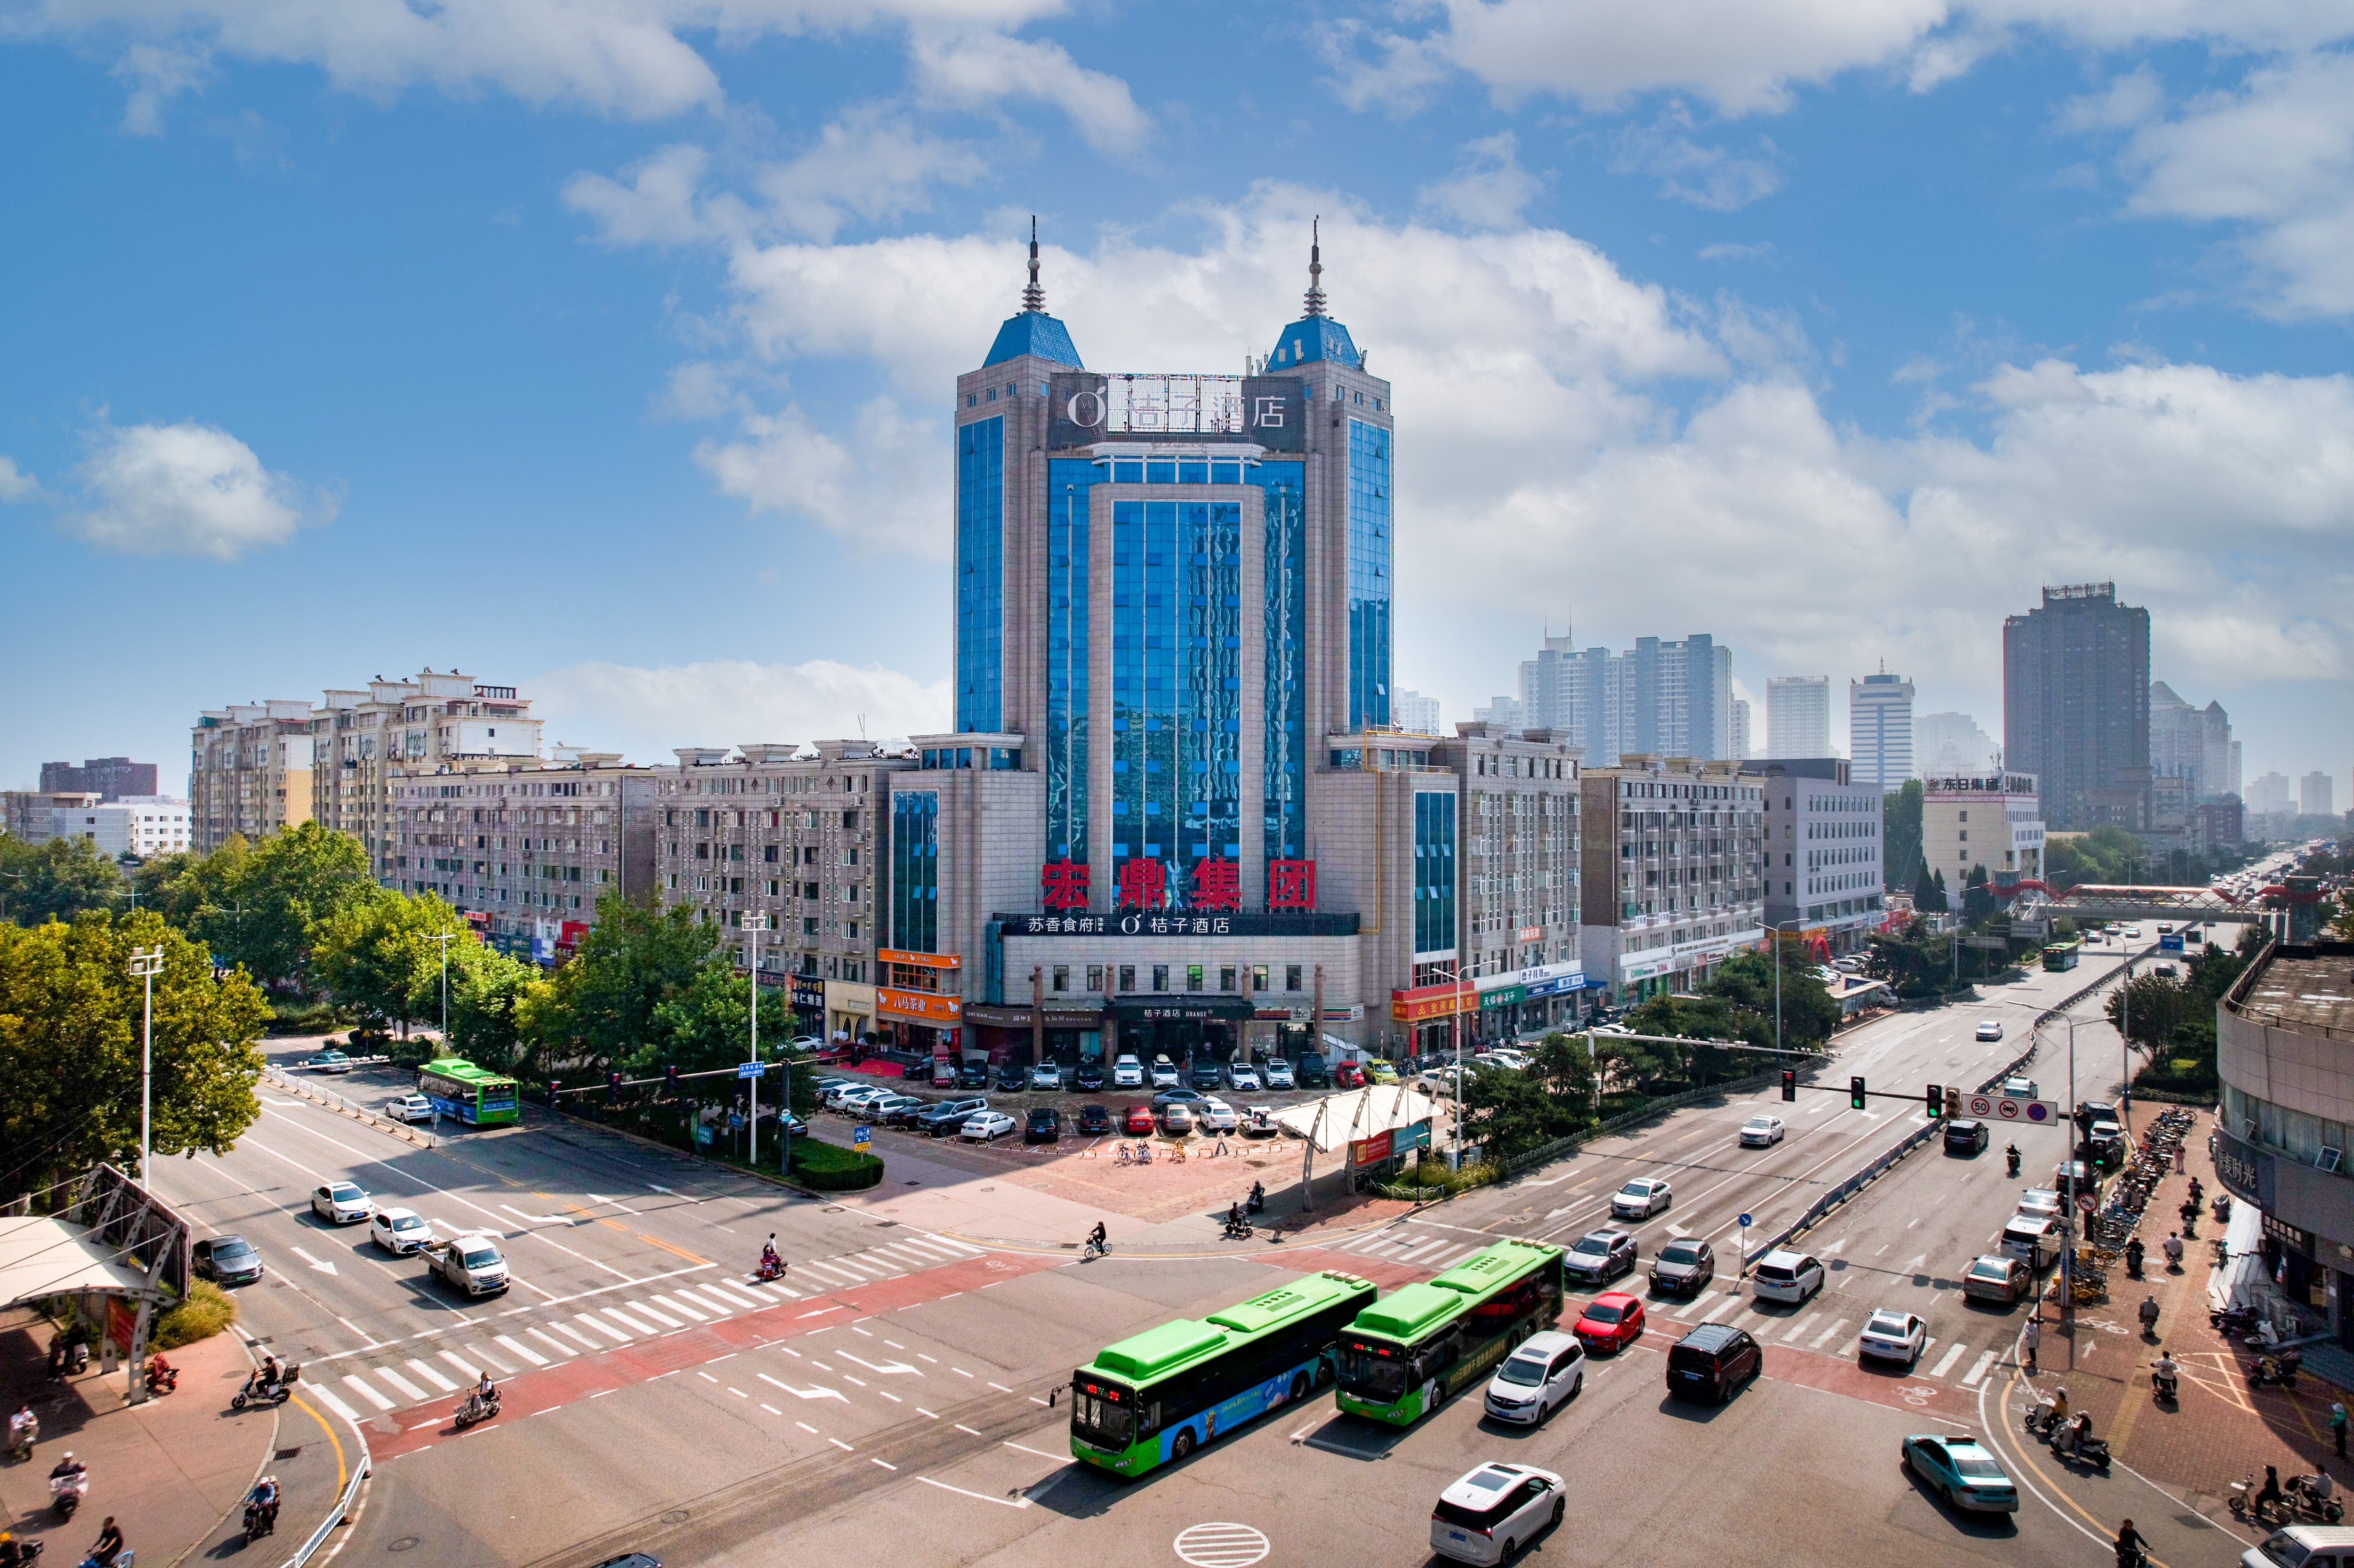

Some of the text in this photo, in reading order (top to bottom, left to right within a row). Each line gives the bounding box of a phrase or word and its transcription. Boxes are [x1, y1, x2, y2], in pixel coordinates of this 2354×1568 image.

[1124, 394, 1286, 427] 桔子酒店
[1943, 778, 1999, 791] 东日集团
[1041, 858, 1316, 910] 宏鼎集团
[1028, 917, 1094, 932] 苏香食府
[1151, 917, 1229, 933] 桔子酒店
[791, 991, 822, 1007] 纯仁烟酒
[894, 996, 927, 1012] 八马茶业
[1483, 991, 1515, 1006] 天福 茗茶
[1144, 1009, 1180, 1018] 桔子酒店
[1975, 1102, 1986, 1111] 50
